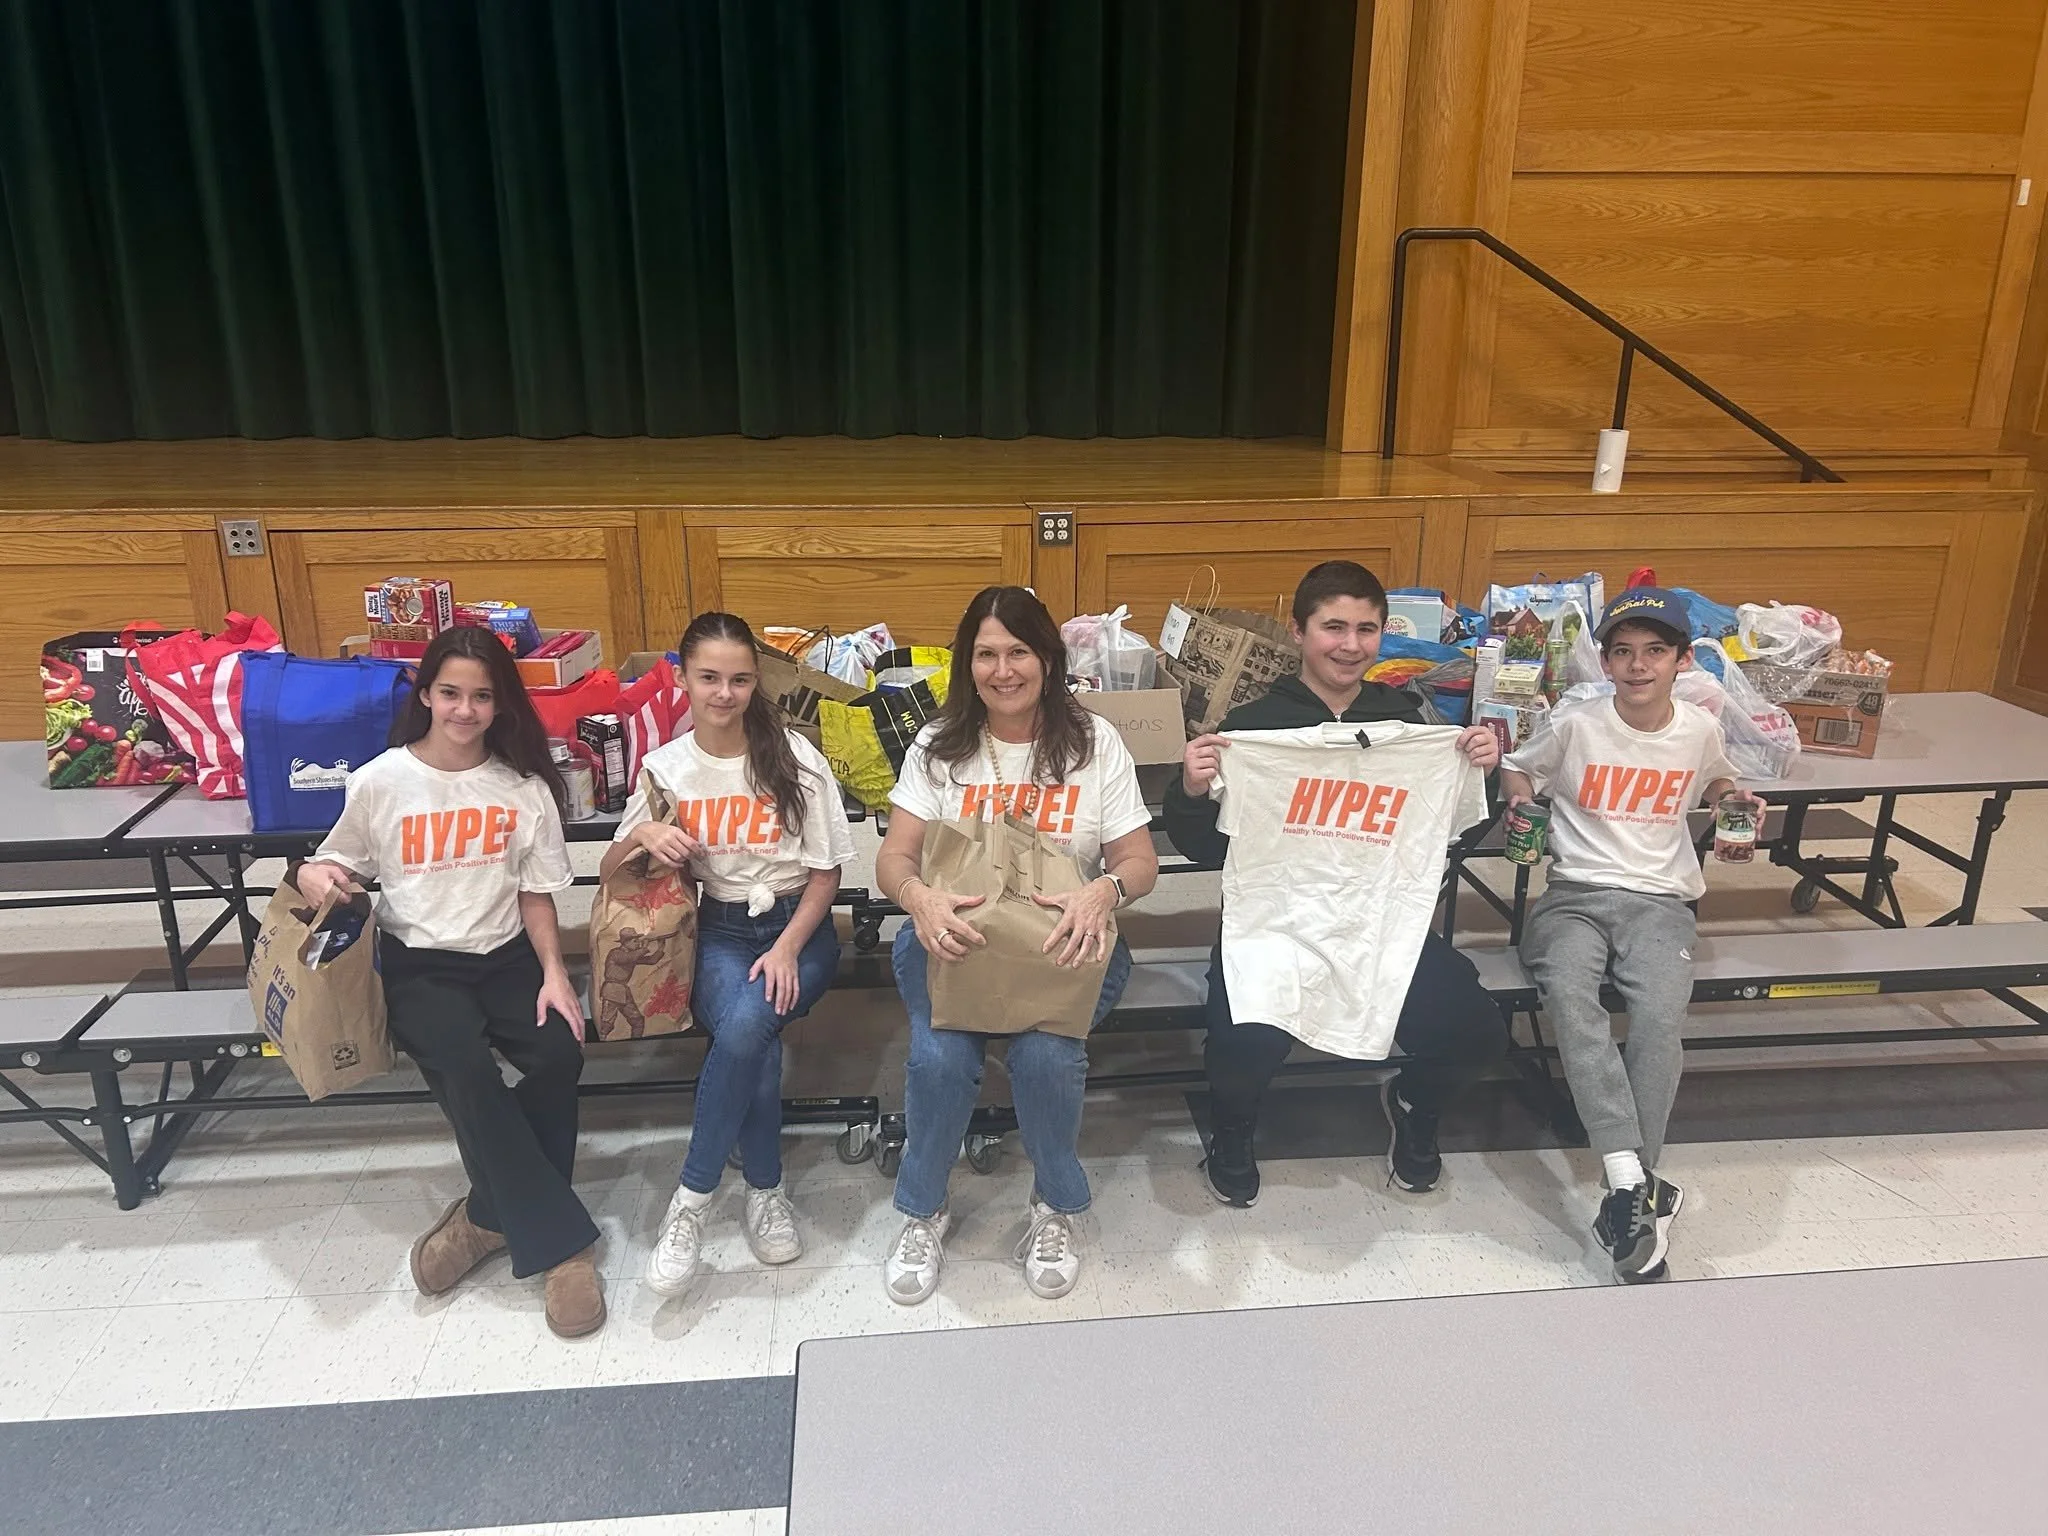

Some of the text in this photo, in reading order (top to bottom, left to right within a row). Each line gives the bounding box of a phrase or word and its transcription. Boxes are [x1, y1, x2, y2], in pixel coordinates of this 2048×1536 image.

[438, 589, 446, 627] Moore
[1865, 695, 1878, 707] 48
[1110, 718, 1163, 732] tions
[1578, 764, 1695, 815] HYPE!
[960, 783, 1081, 833] HYPE!
[1285, 777, 1409, 835] HYPE!
[677, 794, 783, 847] HYPE!
[1604, 814, 1624, 822] Youth
[402, 805, 518, 865] HYPE!
[1051, 837, 1073, 846] ergy
[1282, 826, 1391, 847] Healthy Youth Positive Energy
[429, 861, 453, 873] Youth
[454, 857, 488, 869] Positive
[283, 984, 296, 1001] an
